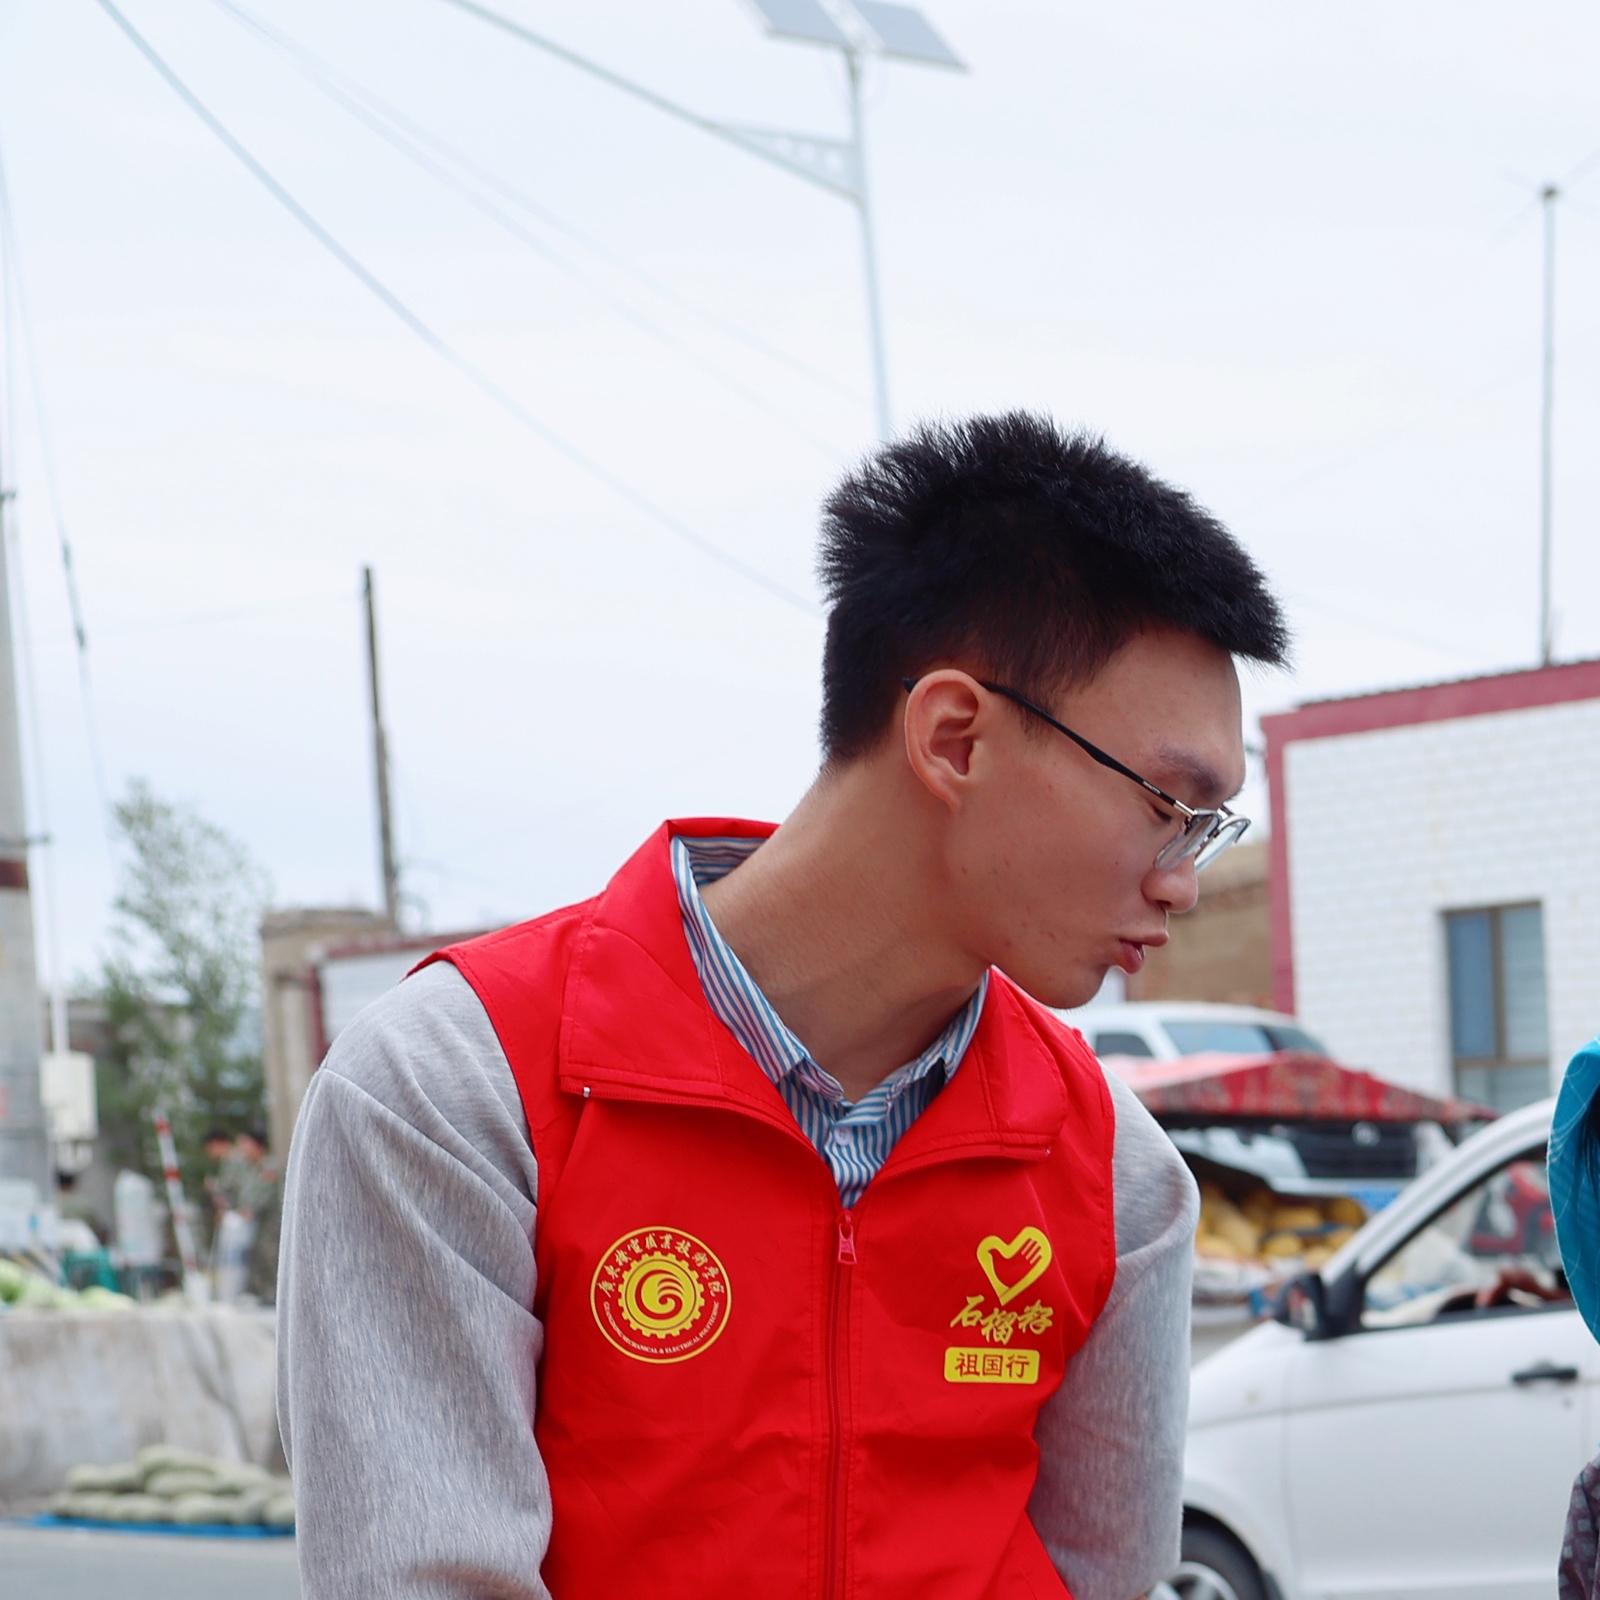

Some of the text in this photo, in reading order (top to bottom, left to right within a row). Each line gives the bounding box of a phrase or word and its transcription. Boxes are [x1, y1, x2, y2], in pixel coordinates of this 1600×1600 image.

[950, 1294, 1053, 1345] 石榴籽
[954, 1352, 1030, 1378] 祖国行
